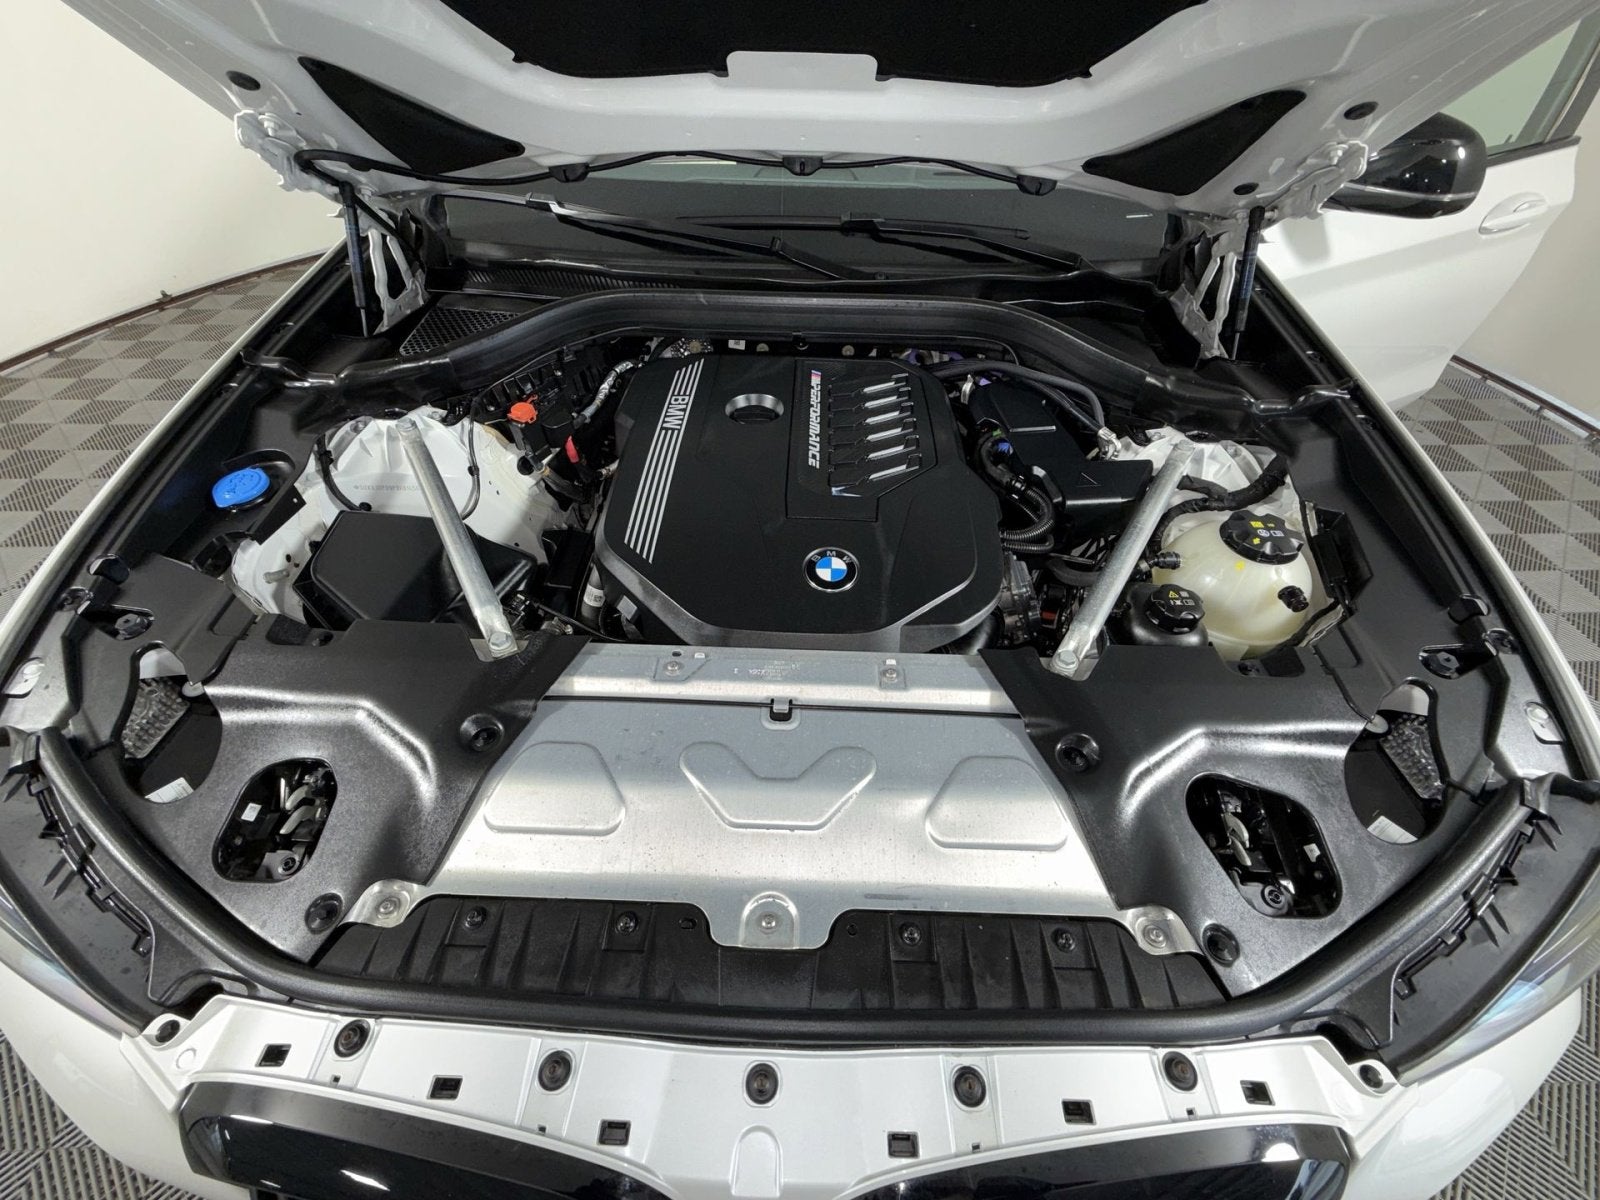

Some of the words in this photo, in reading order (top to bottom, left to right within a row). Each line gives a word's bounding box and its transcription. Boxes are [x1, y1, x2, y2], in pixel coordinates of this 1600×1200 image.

[662, 395, 690, 429] BMW
[808, 382, 821, 470] PERFORMANCE
[810, 550, 851, 563] BMW
